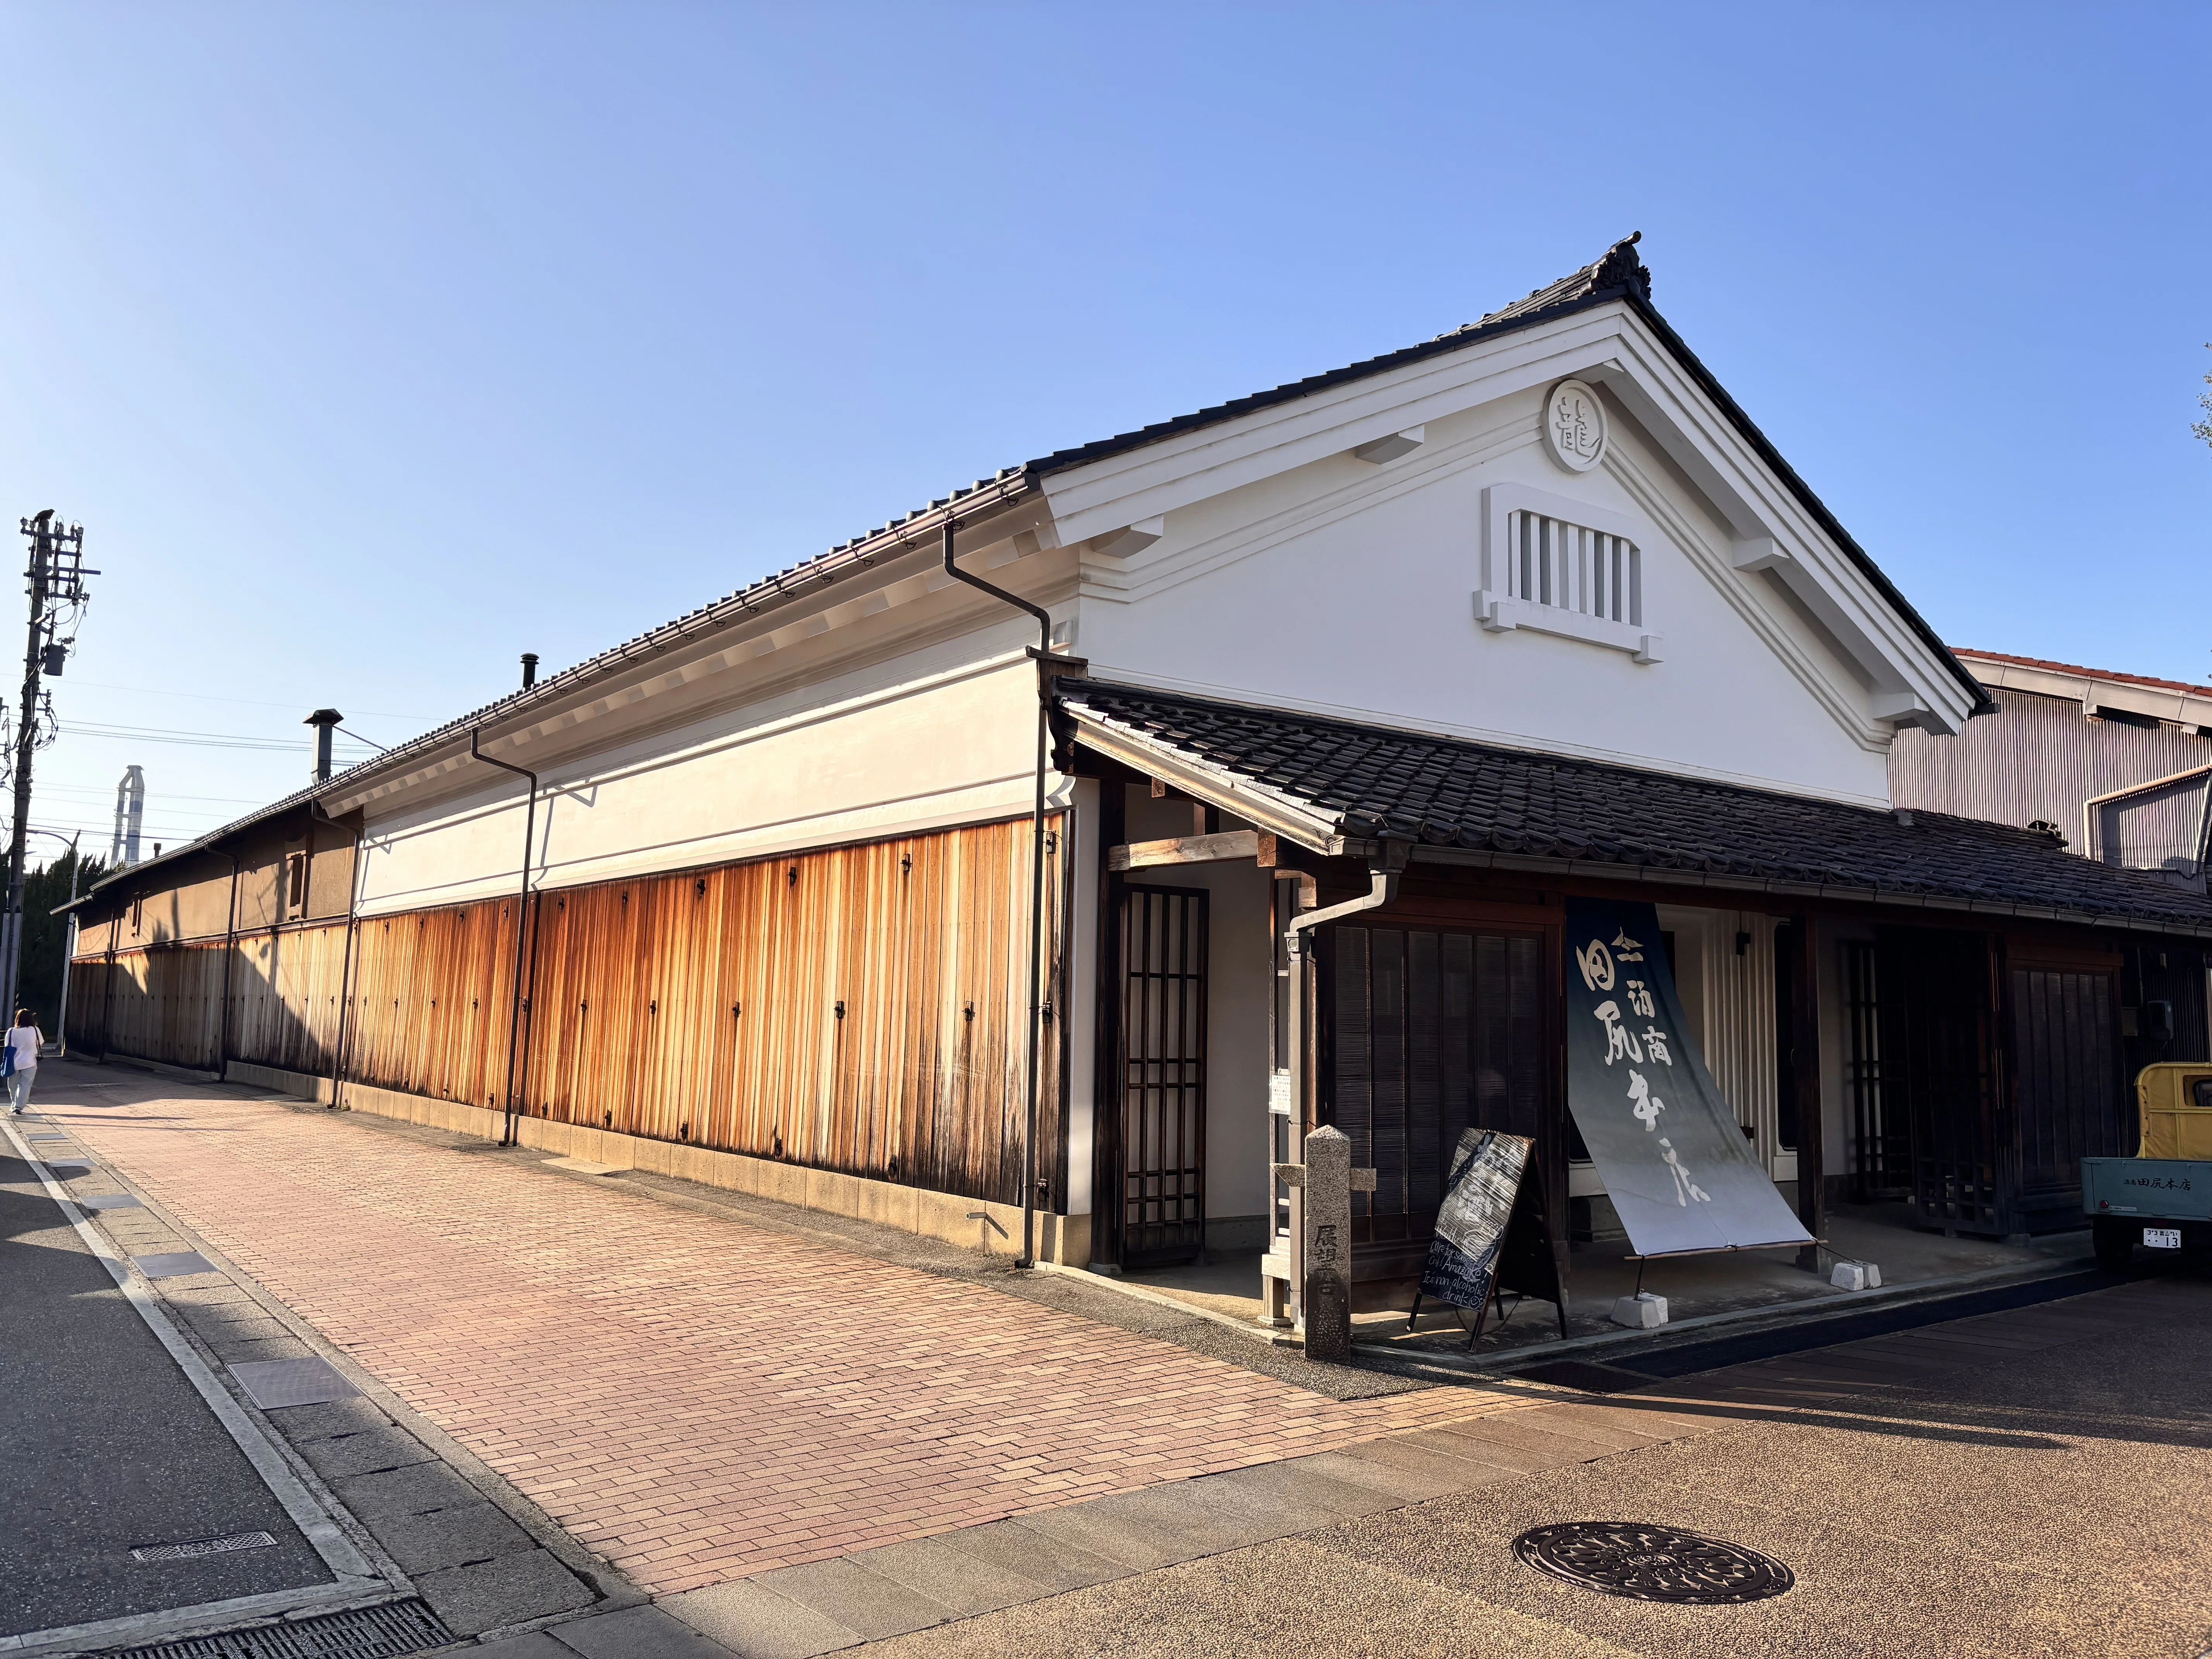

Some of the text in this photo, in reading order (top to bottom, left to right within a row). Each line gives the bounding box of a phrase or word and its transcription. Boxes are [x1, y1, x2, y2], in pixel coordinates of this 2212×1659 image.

[2137, 1177, 2191, 1192] 田尻本店
[1444, 1243, 1455, 1256] for
[1435, 1276, 1485, 1296] non-alcoholic
[1442, 1286, 1468, 1304] drink
